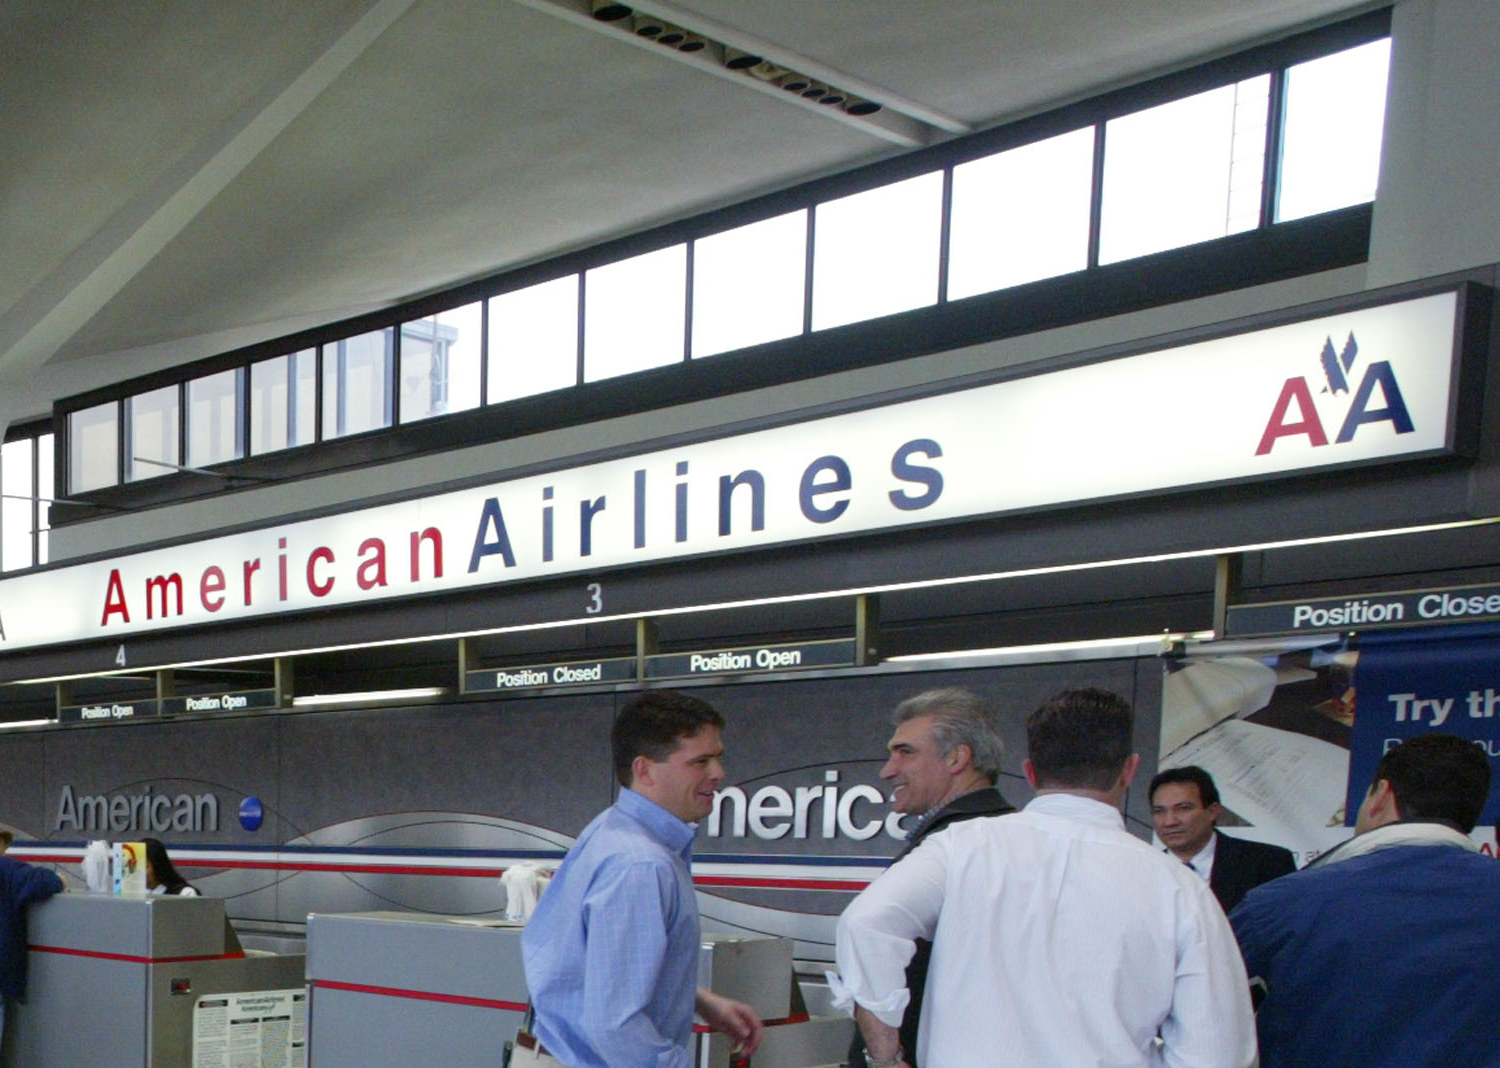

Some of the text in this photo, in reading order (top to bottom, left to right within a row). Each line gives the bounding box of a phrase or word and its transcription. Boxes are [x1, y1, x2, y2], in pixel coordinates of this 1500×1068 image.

[1255, 360, 1415, 456] AA
[586, 583, 602, 614] 3
[1293, 593, 1500, 628] Position Close
[116, 644, 126, 667] 4
[690, 649, 801, 671] Position Open
[496, 664, 602, 687] Position Closed
[81, 705, 134, 719] Position Open
[186, 695, 247, 711] Position Open
[1388, 689, 1500, 727] Try th
[55, 784, 219, 832] American
